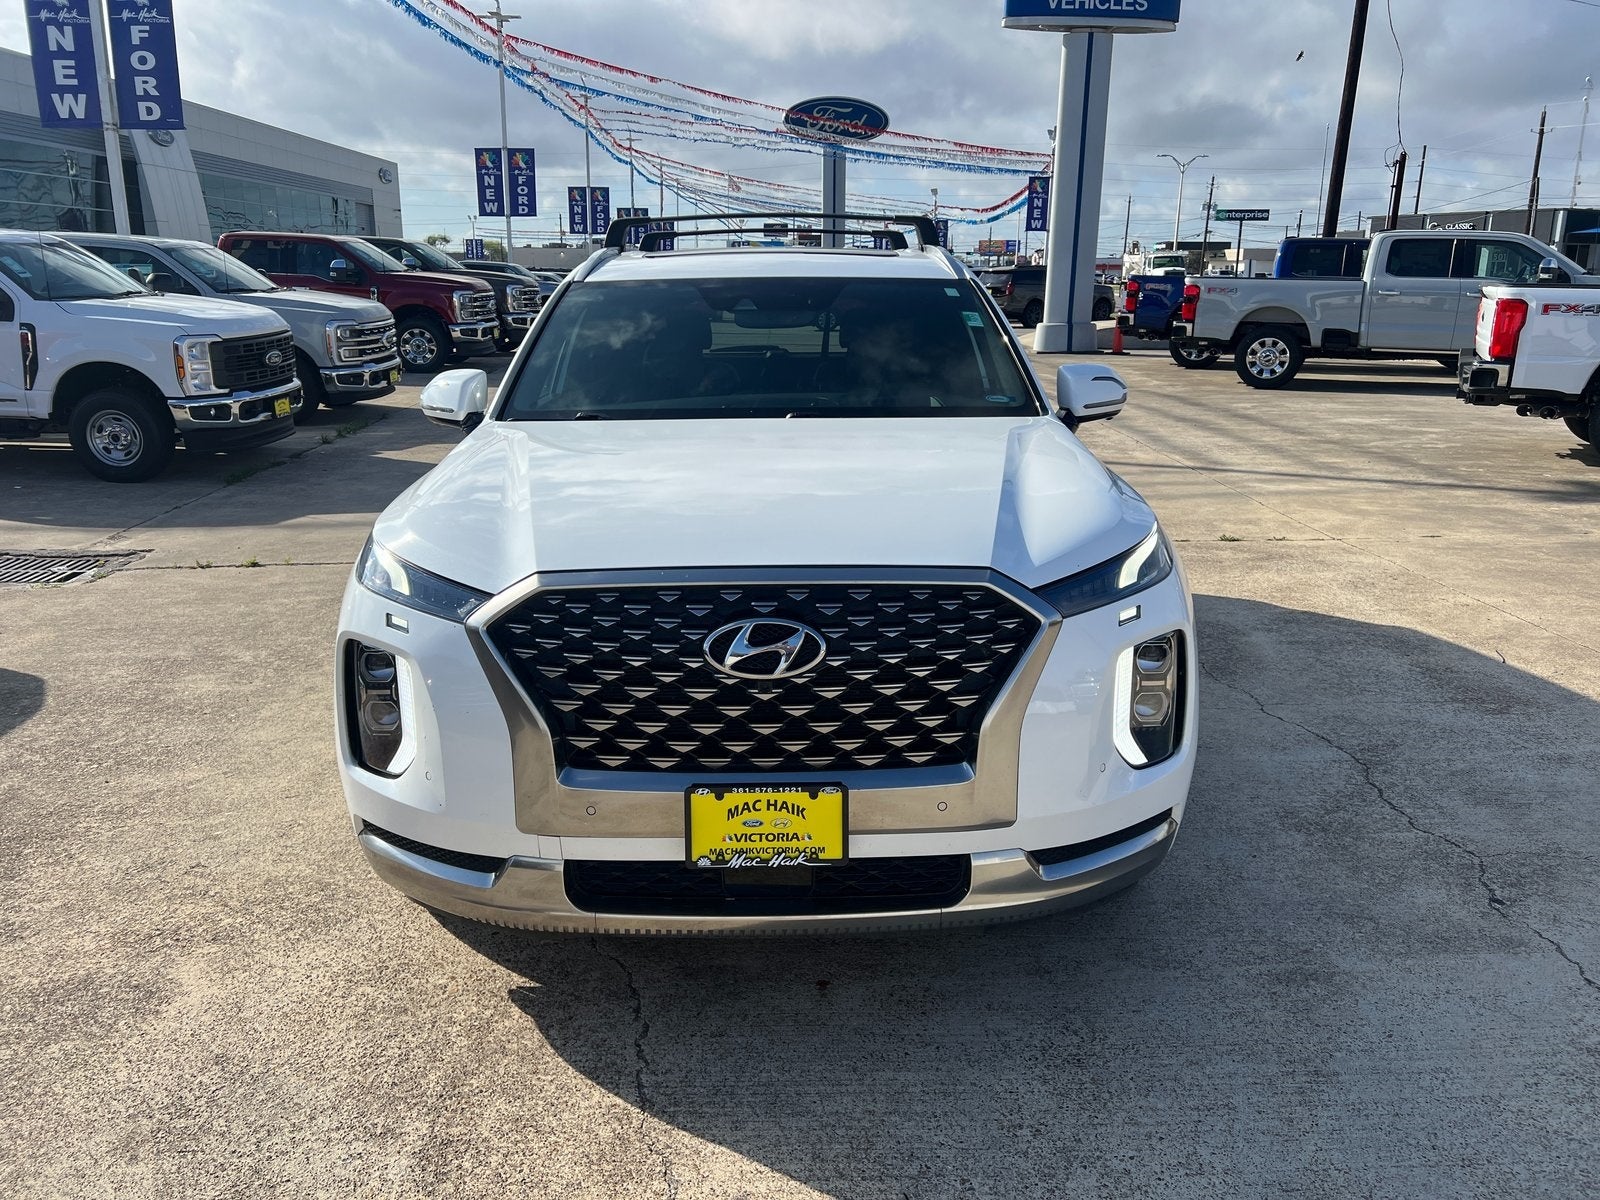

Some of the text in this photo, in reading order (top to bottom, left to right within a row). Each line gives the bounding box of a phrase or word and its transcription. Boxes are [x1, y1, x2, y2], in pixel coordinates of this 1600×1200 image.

[1048, 0, 1148, 11] VEHICLES
[46, 25, 87, 119] NEW
[130, 25, 161, 121] FORD
[806, 105, 868, 133] Ford
[483, 175, 498, 213] NEW
[517, 176, 528, 214] FORD
[573, 205, 583, 232] NEW
[596, 206, 605, 233] FORD
[1031, 198, 1042, 229] NEW
[1219, 210, 1269, 220] enterprise
[1445, 222, 1473, 230] CLASSIC
[1541, 303, 1600, 315] FX4
[727, 799, 807, 821] MAC HAIK
[734, 832, 801, 843] VICTORIA
[726, 852, 808, 869] Mac Haik
